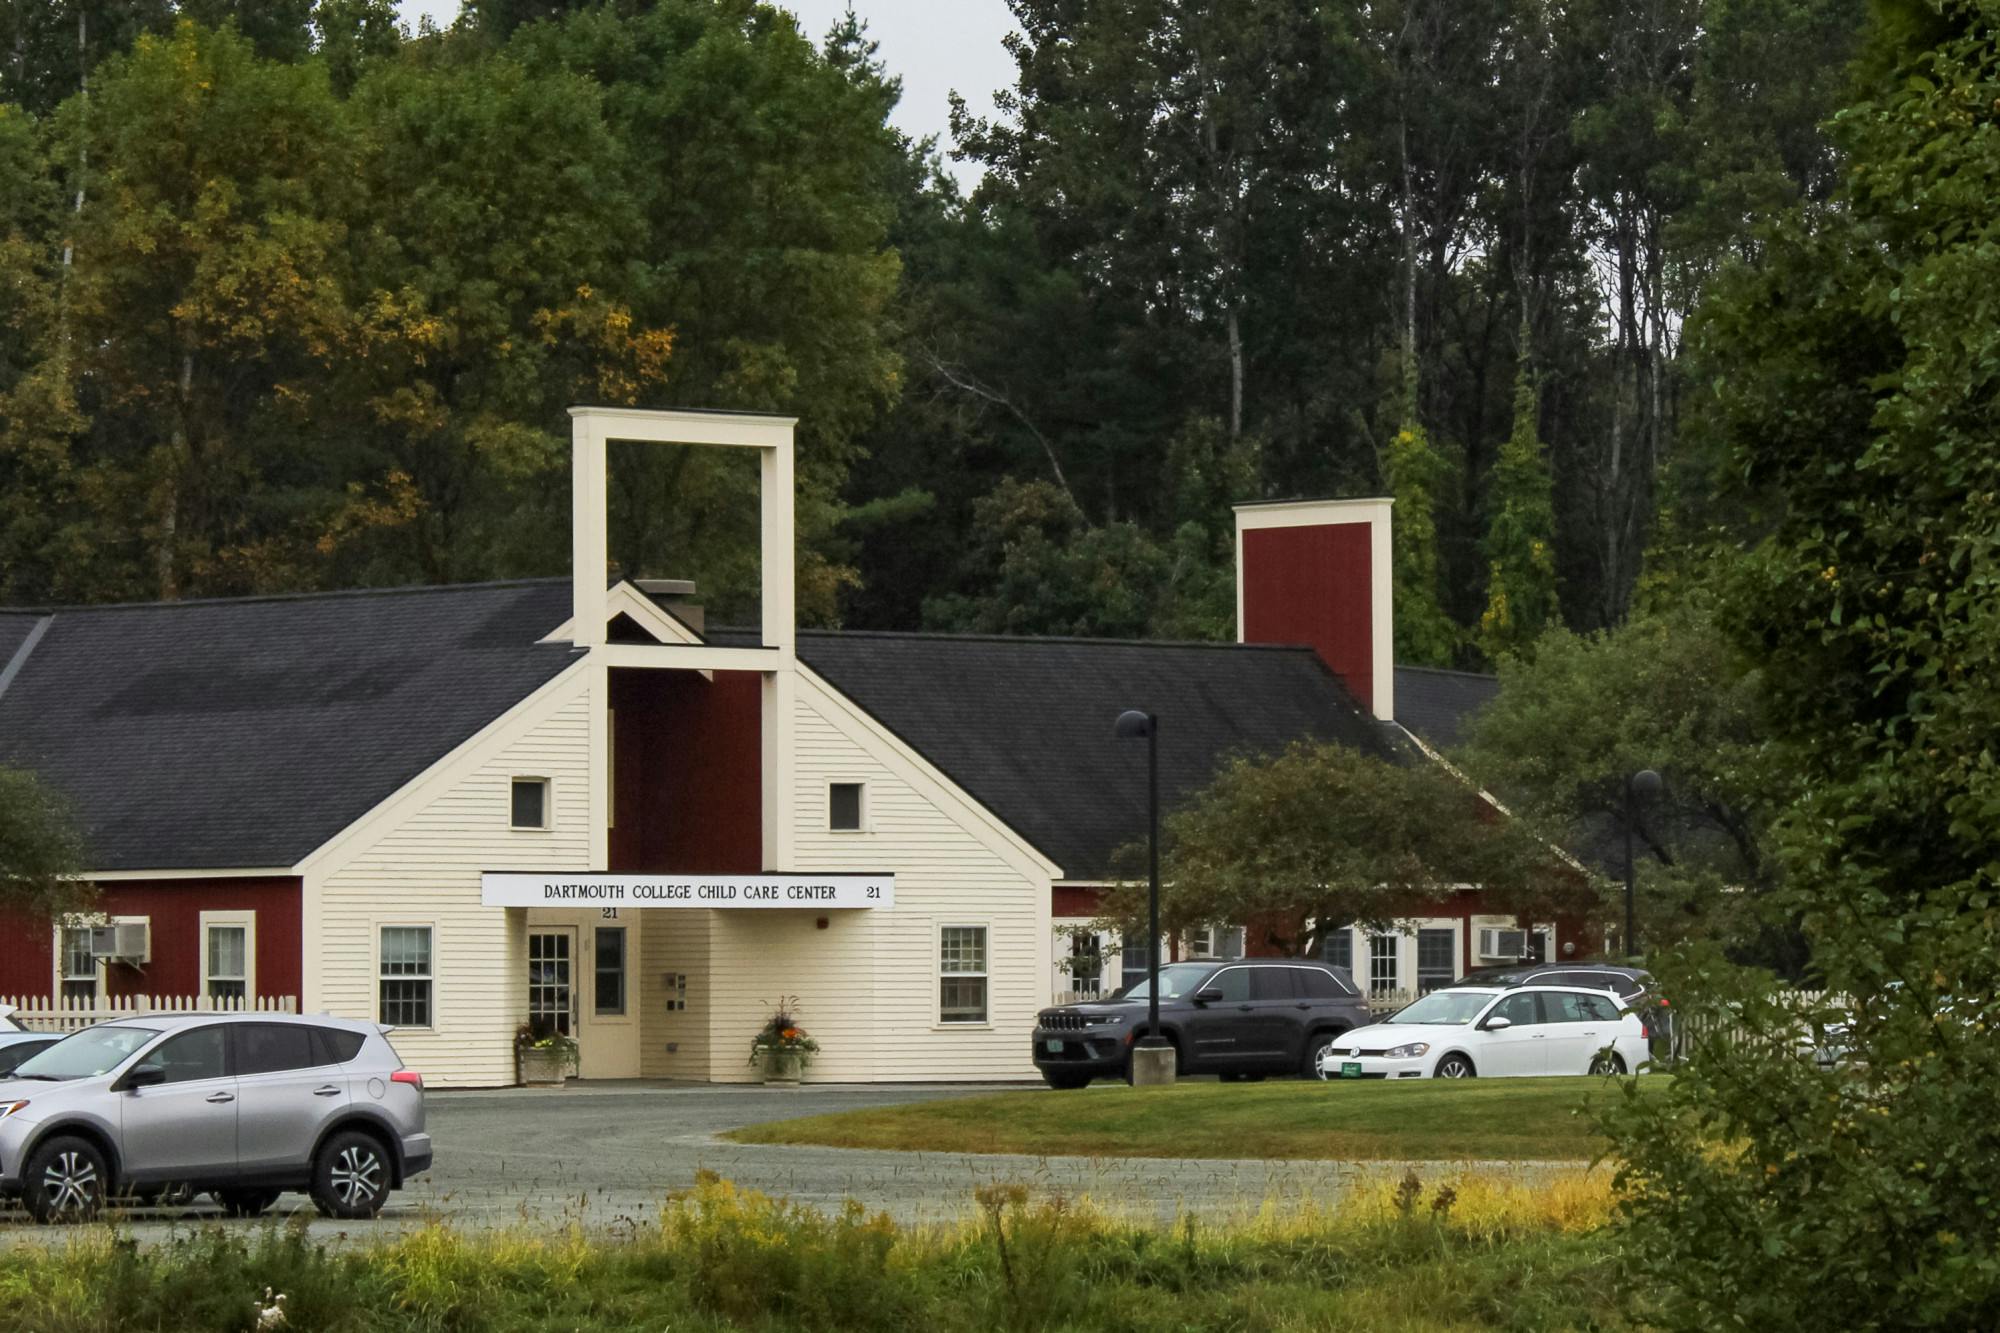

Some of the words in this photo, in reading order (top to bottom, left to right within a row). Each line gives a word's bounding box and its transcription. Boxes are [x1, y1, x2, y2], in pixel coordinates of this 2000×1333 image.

[544, 884, 625, 899] DARTMOUTH
[632, 885, 692, 899] COLLEGE
[697, 885, 737, 899] CHILD
[743, 885, 779, 899] CARE
[787, 885, 836, 900] CENTER
[866, 886, 881, 899] 21
[602, 906, 618, 919] 21
